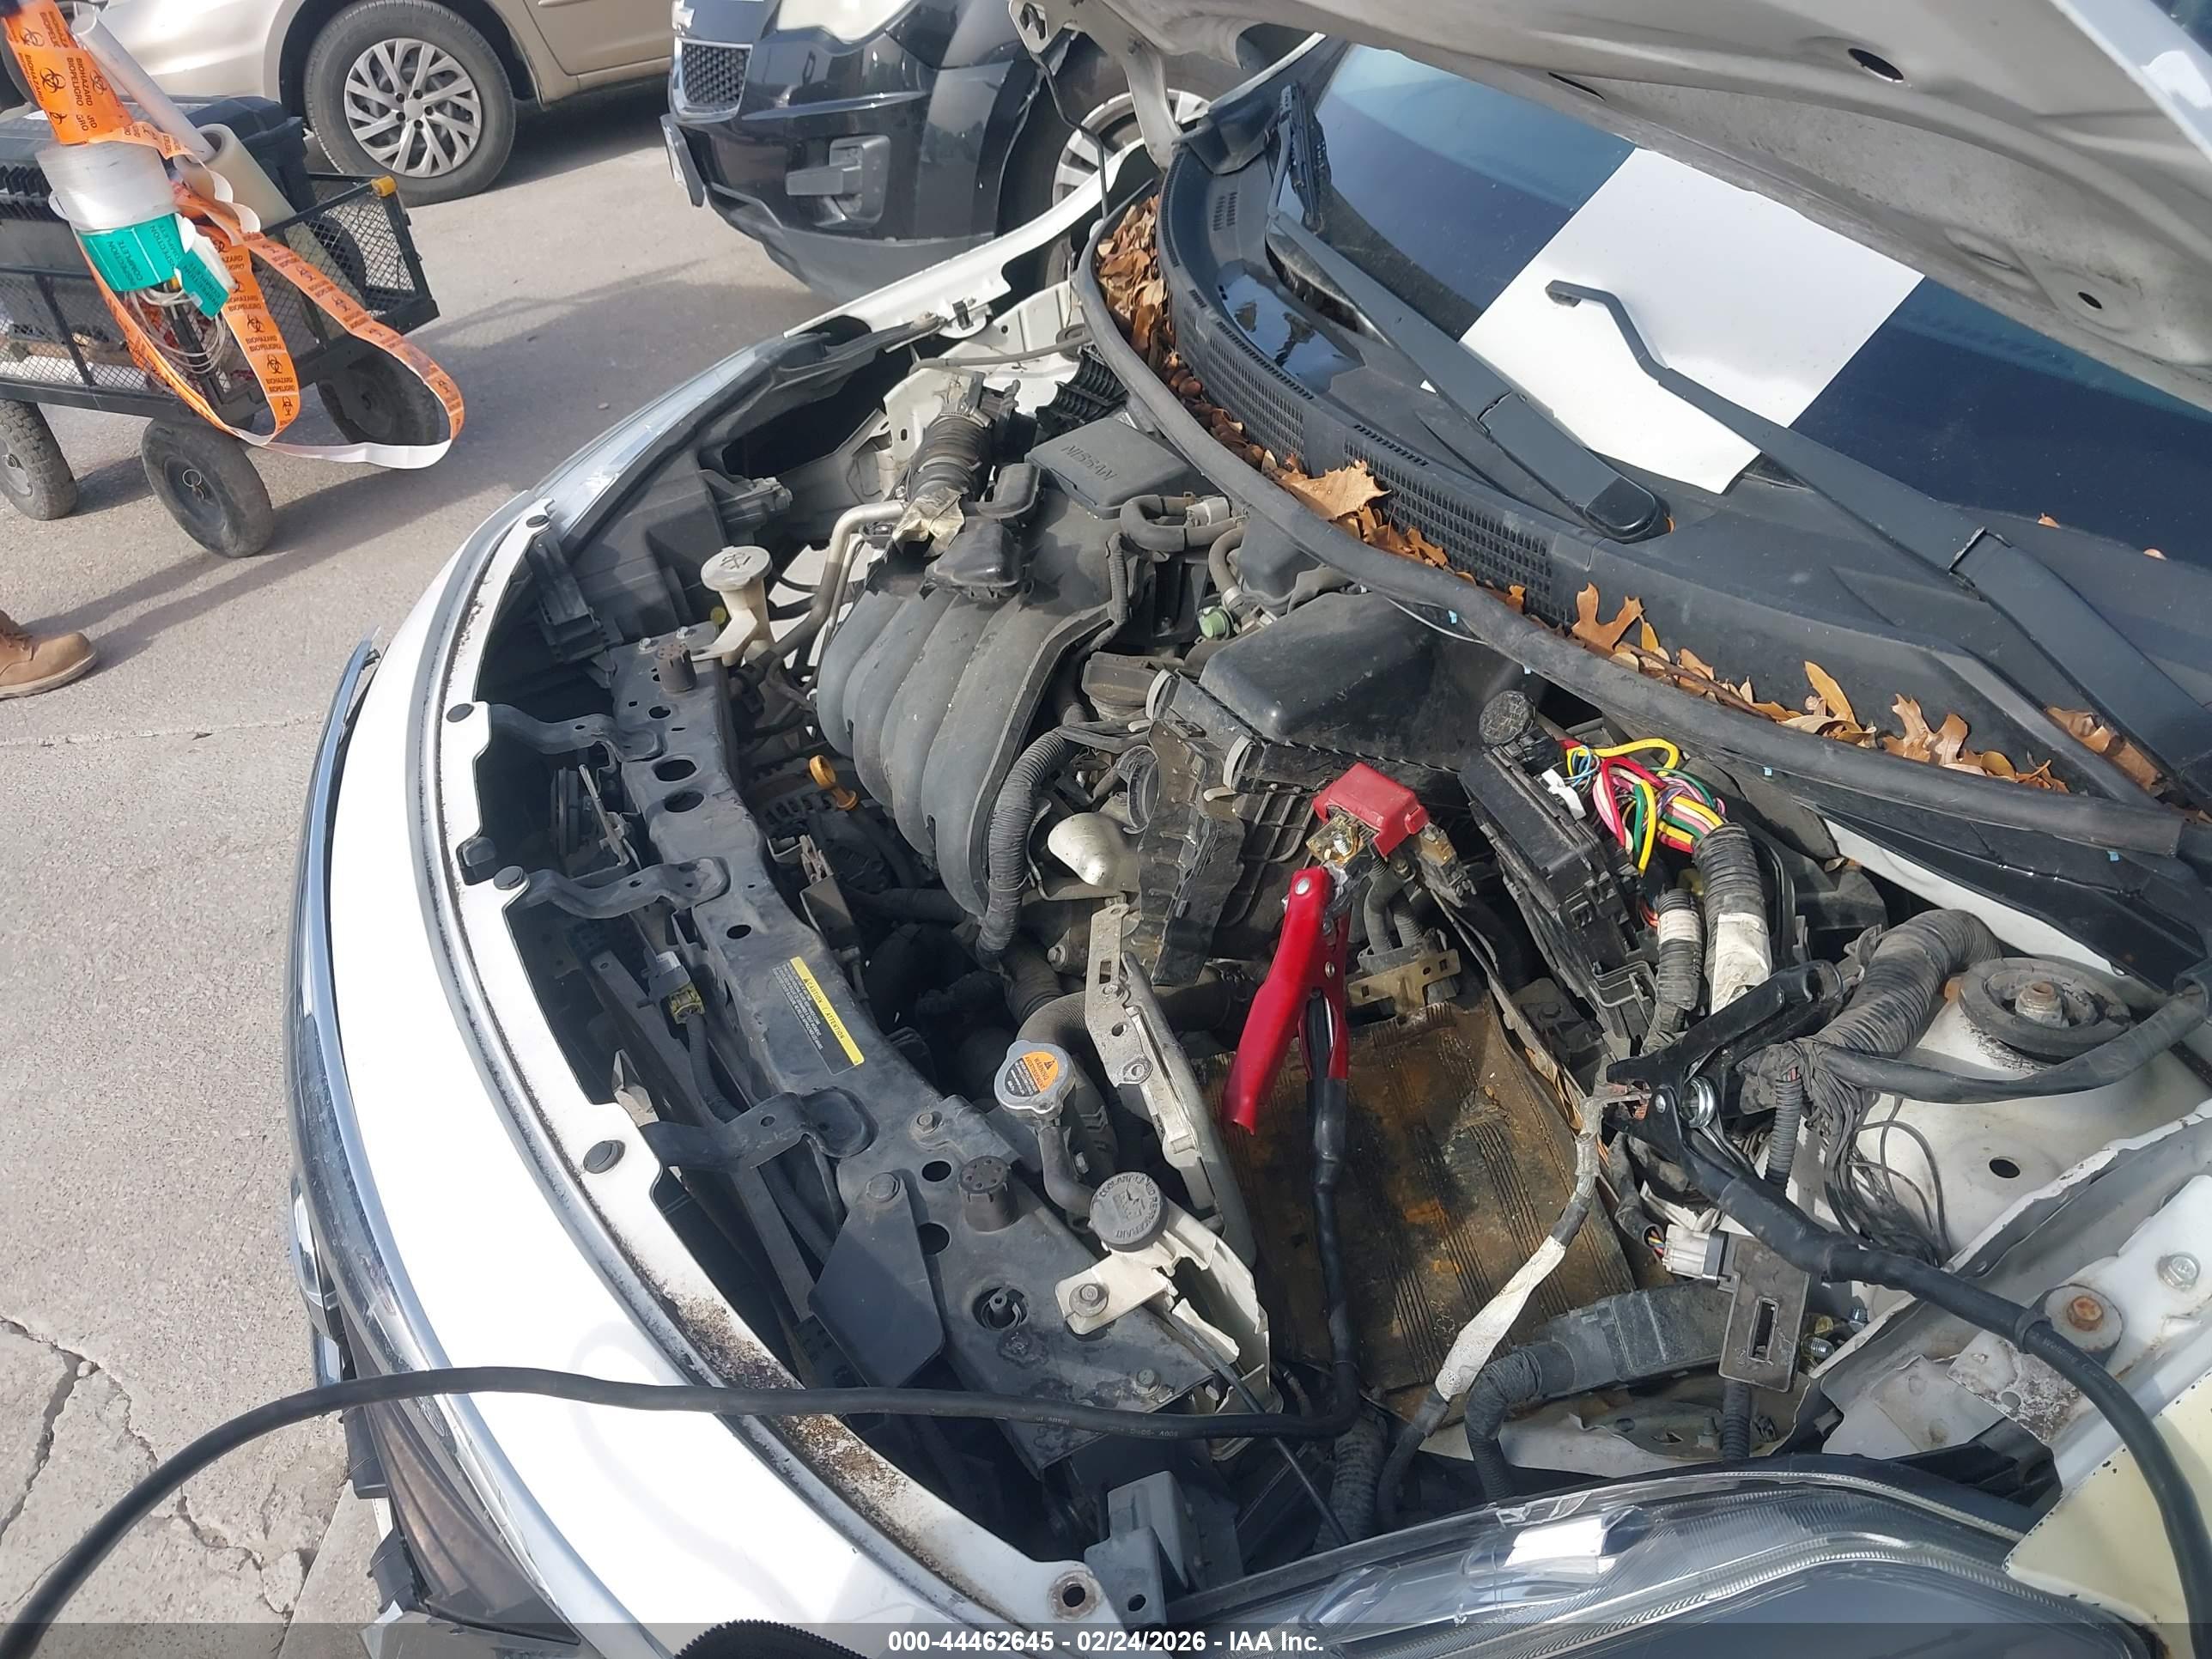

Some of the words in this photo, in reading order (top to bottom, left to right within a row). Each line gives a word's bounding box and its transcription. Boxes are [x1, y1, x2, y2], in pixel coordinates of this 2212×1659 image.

[67, 57, 84, 106] BIOPELIGRO
[76, 58, 93, 106] BIOHAZARD
[108, 240, 137, 286] INSPECTION
[118, 240, 143, 282] COMPLETE
[245, 335, 278, 344] BIOHAZARD
[249, 343, 282, 352] BIOPELIGRO
[1060, 445, 1118, 481] NISSAN
[806, 979, 823, 1004] CAUTION
[825, 1012, 846, 1039] ATTENTION
[1034, 1056, 1050, 1081] WARNING
